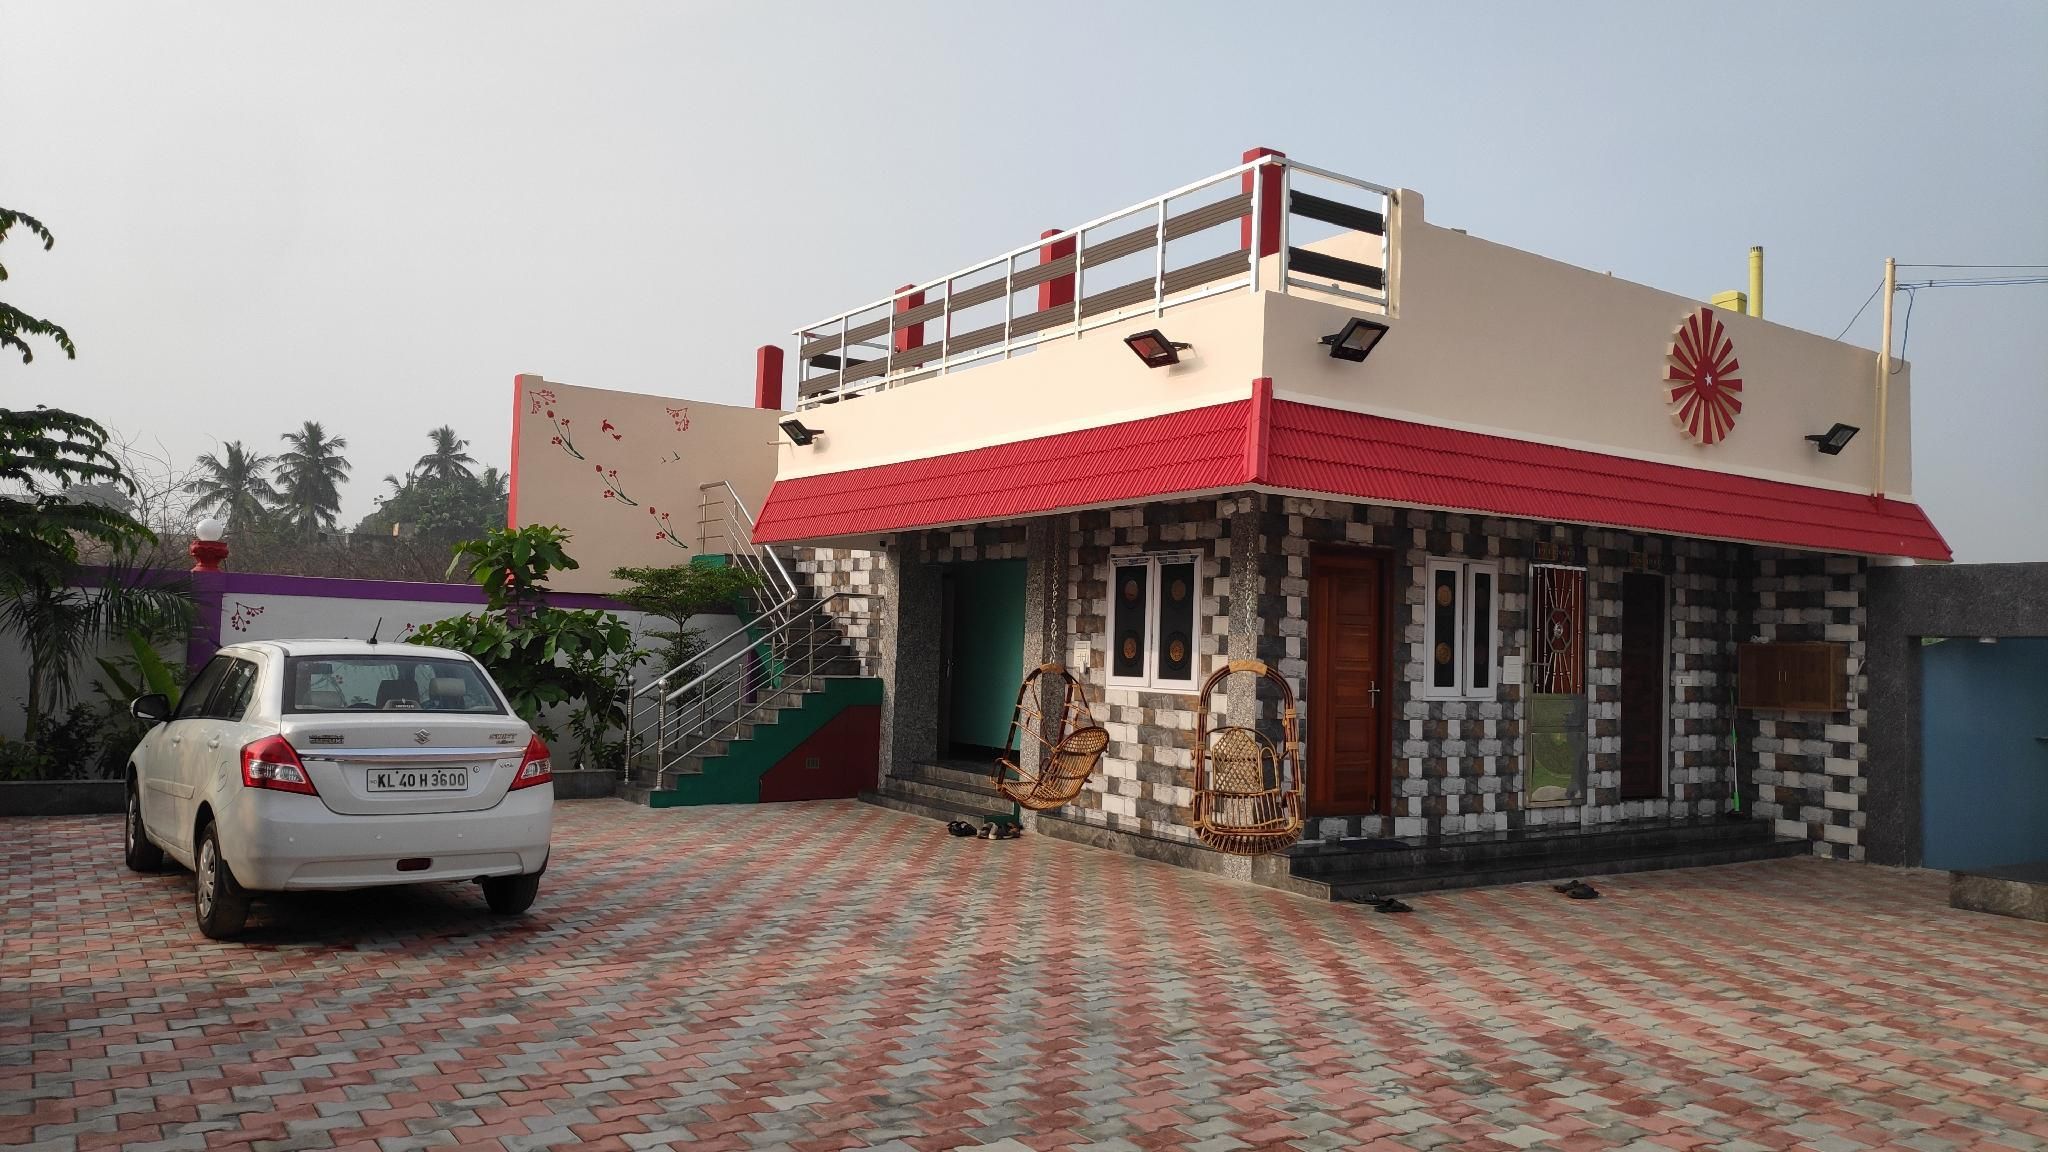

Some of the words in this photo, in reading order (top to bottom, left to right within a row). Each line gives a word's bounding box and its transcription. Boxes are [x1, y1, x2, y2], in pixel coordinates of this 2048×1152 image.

[377, 773, 395, 788] KL
[399, 773, 415, 787] 40
[419, 773, 428, 787] H
[431, 773, 465, 786] 3600
